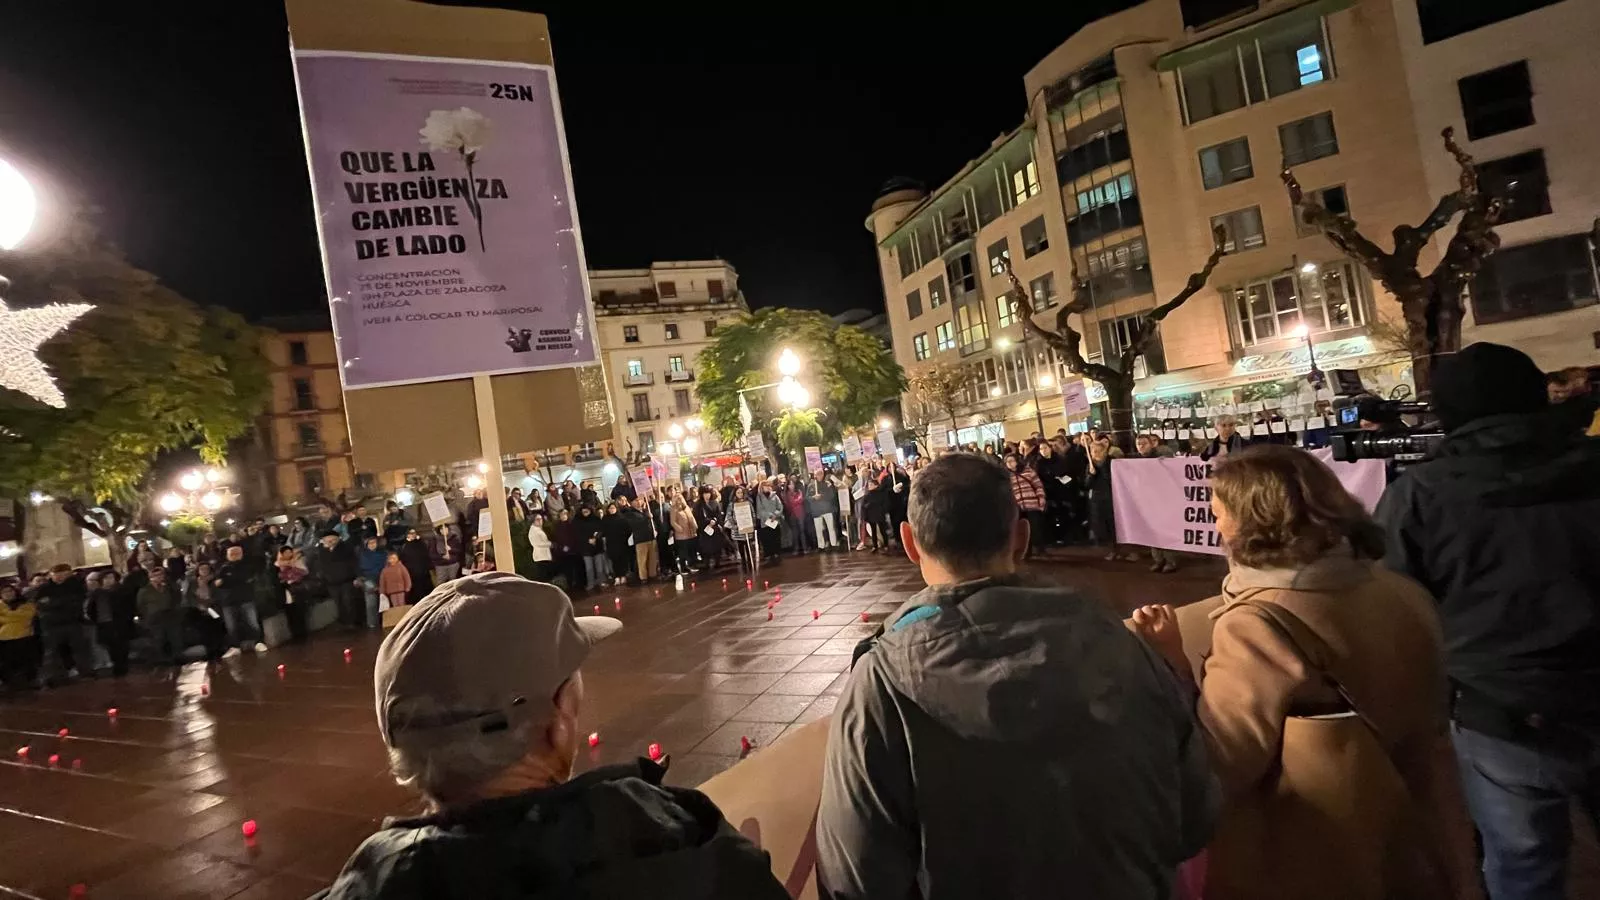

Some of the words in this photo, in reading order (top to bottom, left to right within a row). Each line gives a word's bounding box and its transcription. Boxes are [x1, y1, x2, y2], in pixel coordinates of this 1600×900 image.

[489, 82, 534, 102] 25N
[340, 151, 397, 175] QUE
[402, 152, 435, 172] LA
[344, 176, 508, 203] VERGÜENZA
[352, 205, 459, 231] CAMBIE
[355, 238, 390, 260] DE
[395, 234, 467, 256] LADO
[375, 282, 393, 290] DE
[395, 277, 465, 289] NOVIEMBRE
[384, 288, 422, 298] PLAZA
[425, 287, 441, 296] DE
[444, 284, 507, 295] ZARAGOZA
[362, 299, 411, 310] HUESCA
[405, 311, 462, 322] COLOCAR
[1184, 529, 1203, 546] DE
[1207, 531, 1222, 547] LA
